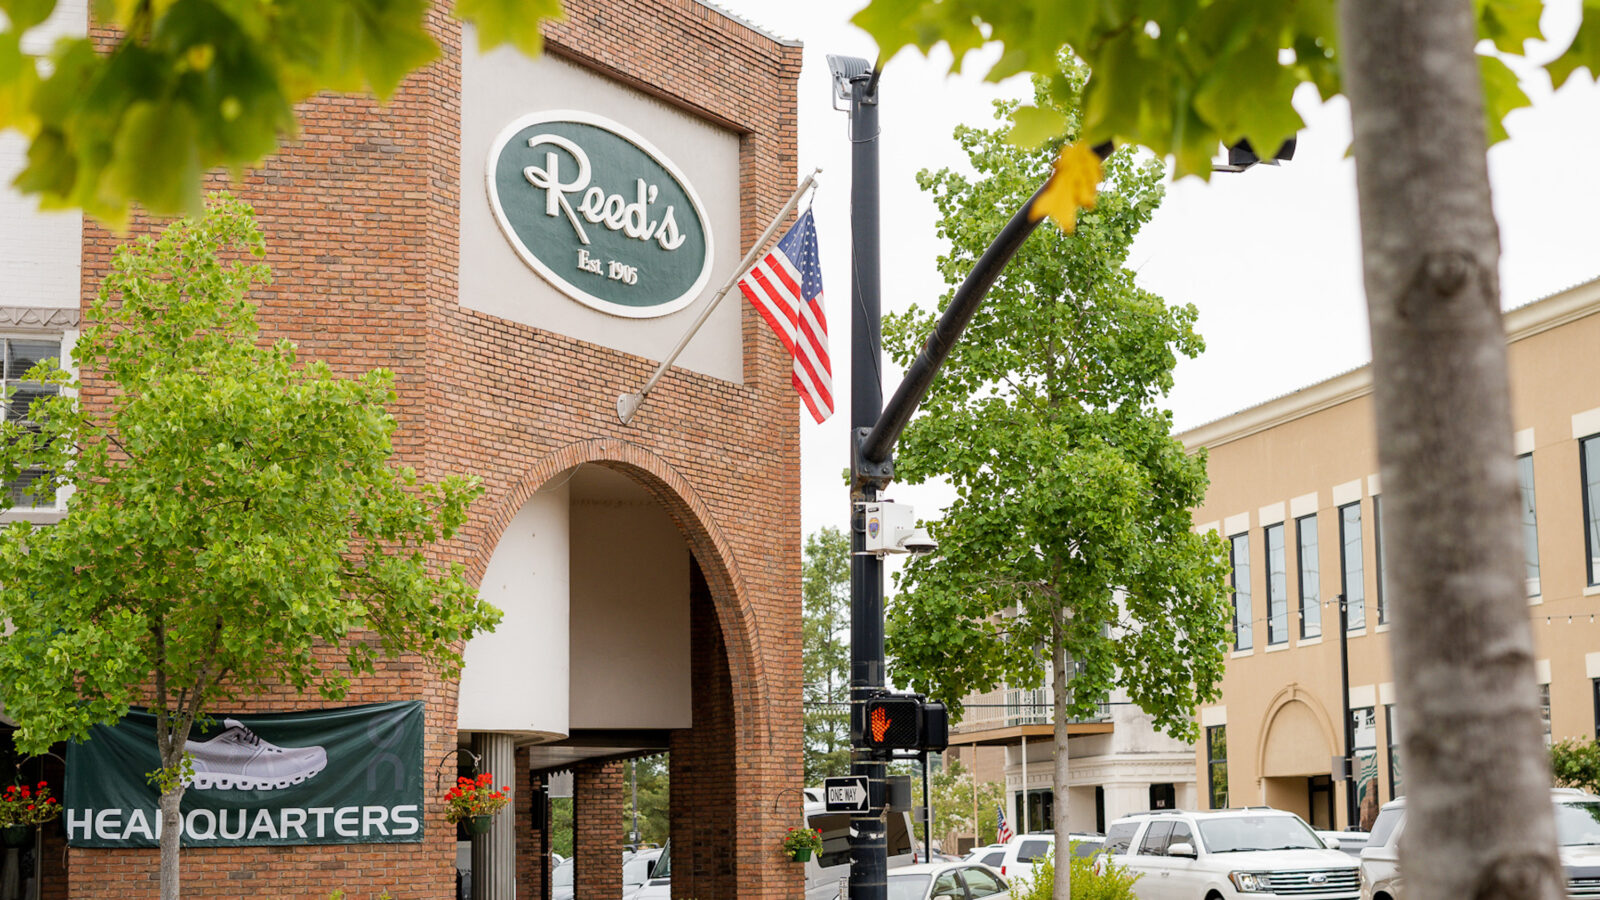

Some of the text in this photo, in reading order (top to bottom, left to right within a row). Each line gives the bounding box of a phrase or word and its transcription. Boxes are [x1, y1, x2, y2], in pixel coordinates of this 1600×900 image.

[523, 133, 686, 251] Reed's
[577, 248, 638, 285] Est. 1905
[830, 787, 857, 802] ONE WAY
